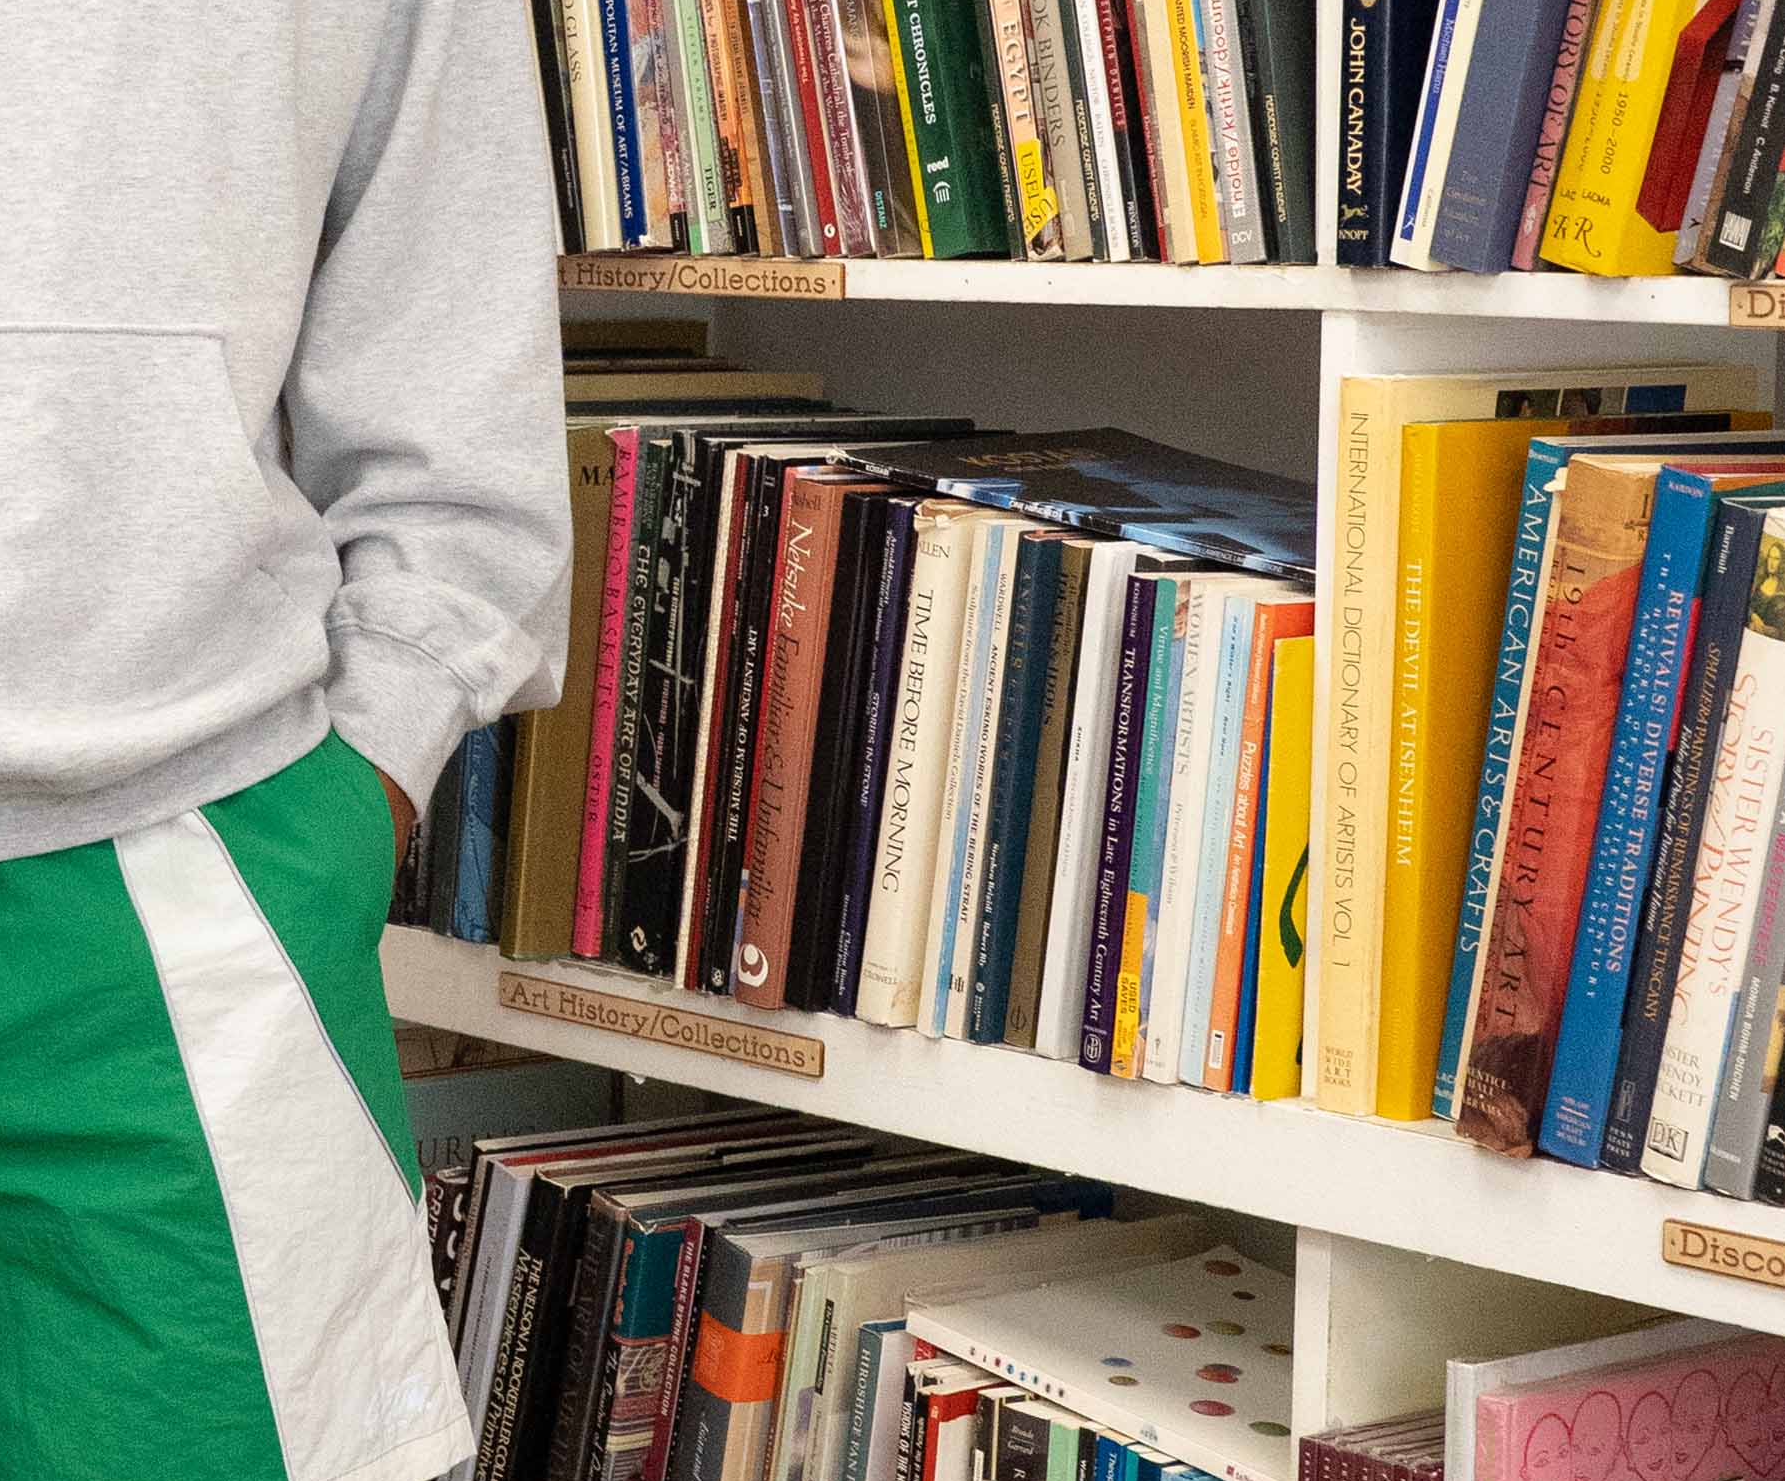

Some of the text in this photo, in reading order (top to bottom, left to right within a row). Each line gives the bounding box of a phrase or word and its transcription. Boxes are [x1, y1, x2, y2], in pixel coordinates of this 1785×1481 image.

[563, 12, 581, 84] GLASS
[1351, 19, 1366, 79] JOHN
[611, 57, 624, 113] MUSEUM
[1041, 33, 1065, 149] BINDERS
[927, 156, 949, 173] reed
[1345, 82, 1365, 196] CANADAY
[1232, 229, 1252, 246] DCV
[1339, 228, 1369, 241] KNOPF
[574, 262, 827, 296] History/Collections
[775, 518, 813, 633] Netsuke
[881, 588, 934, 894] TIME BEFORE MORNING
[1110, 646, 1138, 815] TRANSFORMATIONS
[1492, 561, 1589, 1039] 19th CENTURY ART
[1106, 836, 1118, 865] Late
[1099, 866, 1117, 940] Eighteenth
[1093, 941, 1110, 994] Century
[510, 977, 807, 1070] Art History/Collections
[1086, 996, 1101, 1022] Art
[1129, 981, 1138, 1014] USED
[1650, 1129, 1681, 1153] DK
